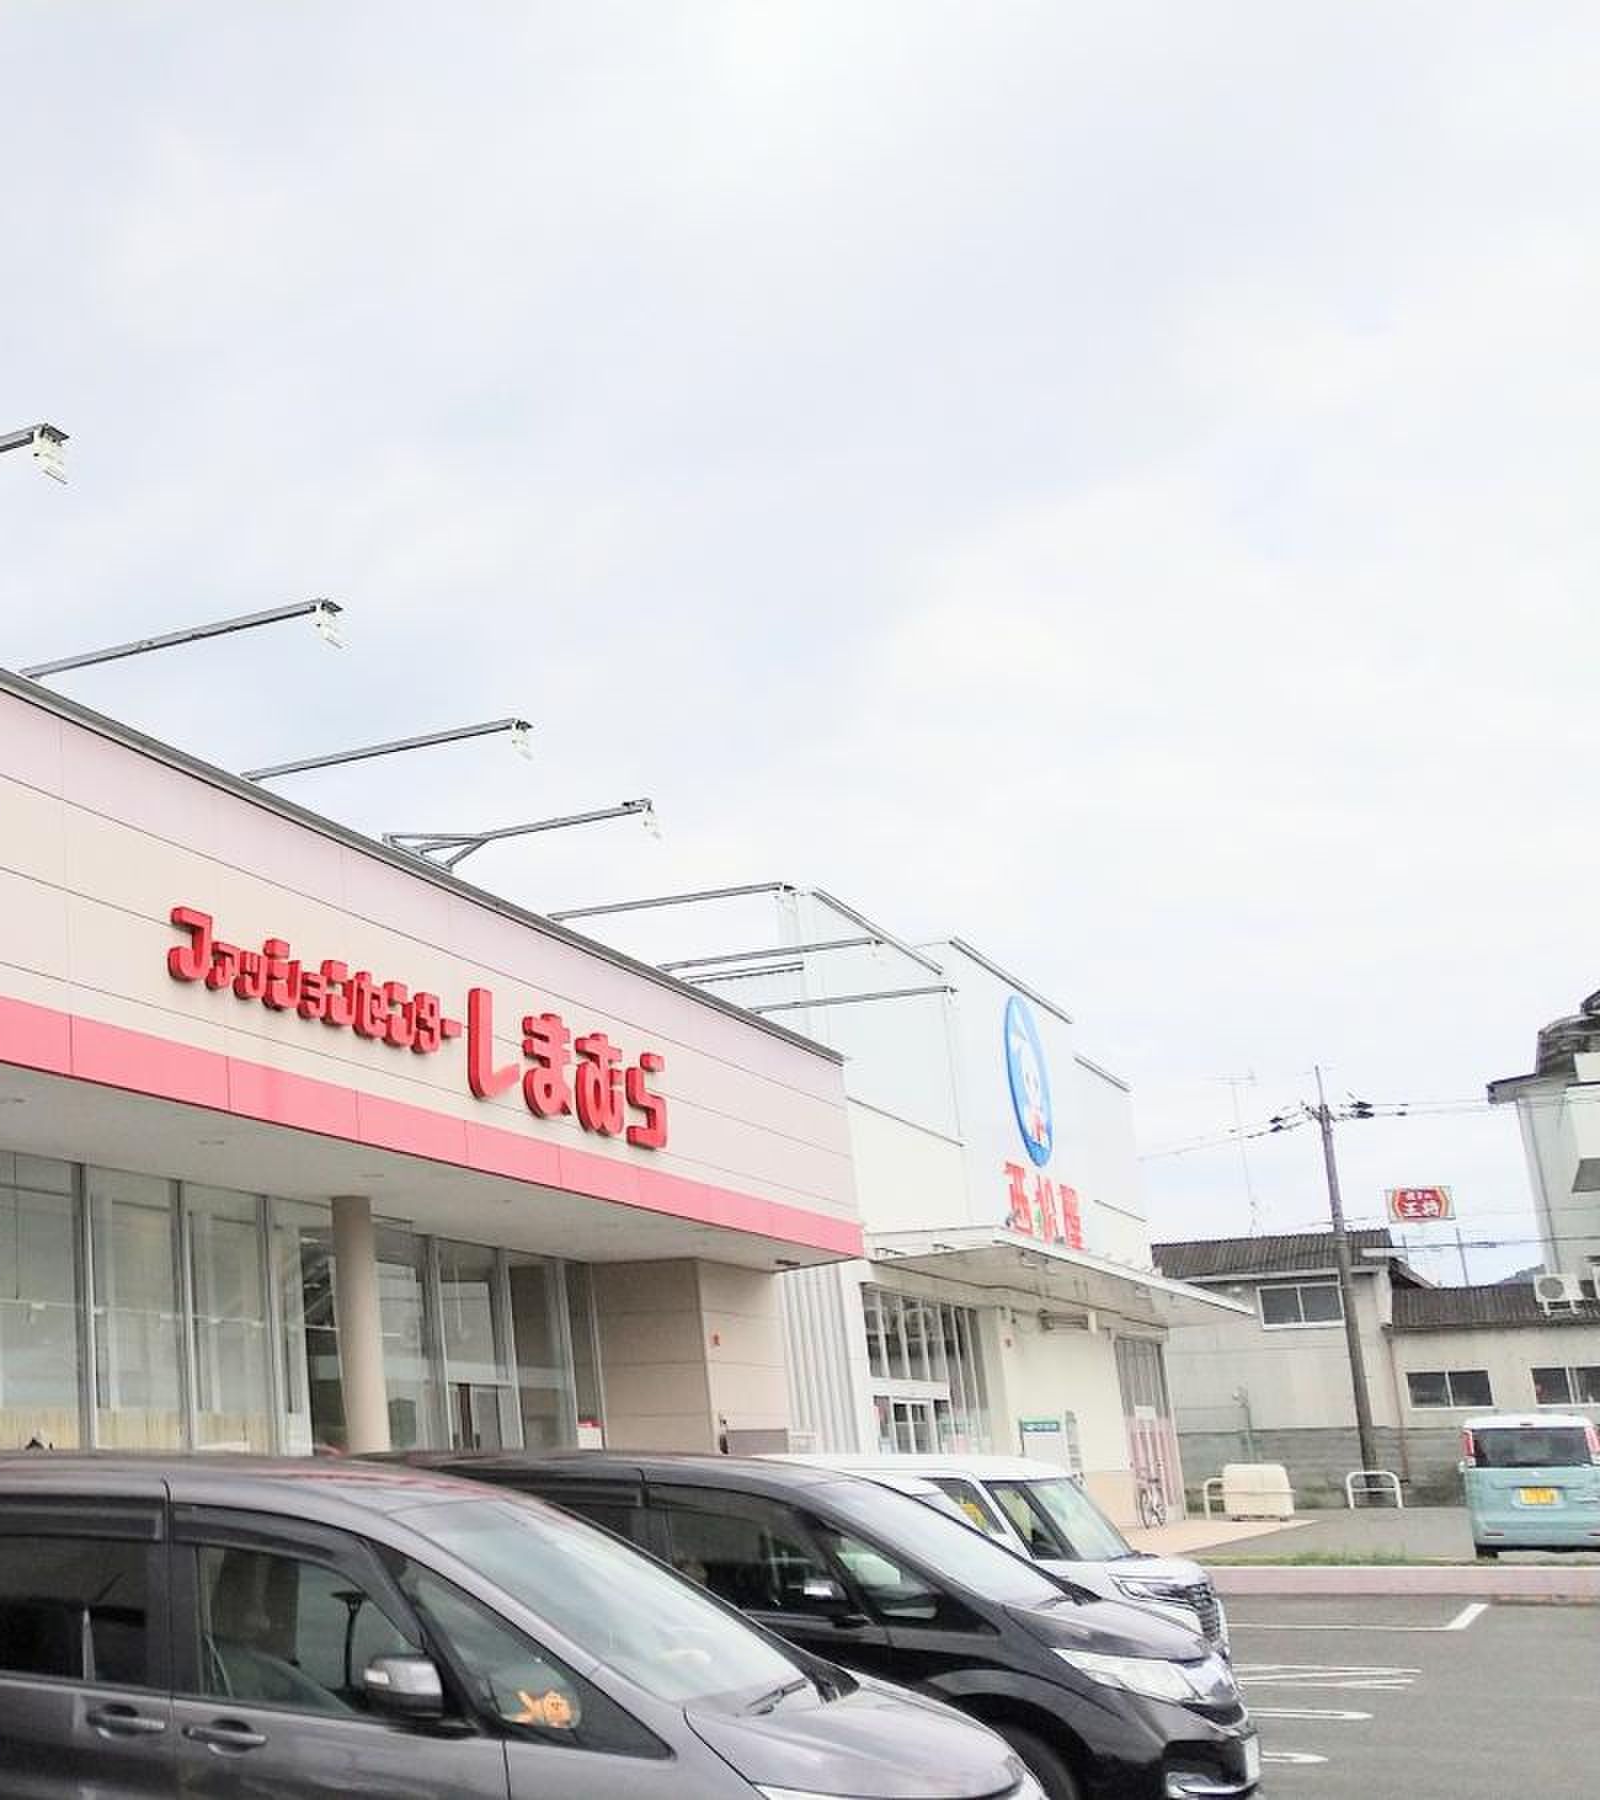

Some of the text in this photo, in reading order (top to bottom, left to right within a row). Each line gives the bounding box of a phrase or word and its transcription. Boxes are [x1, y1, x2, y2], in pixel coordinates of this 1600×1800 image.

[167, 906, 667, 1149] ファッションセンター しまむら
